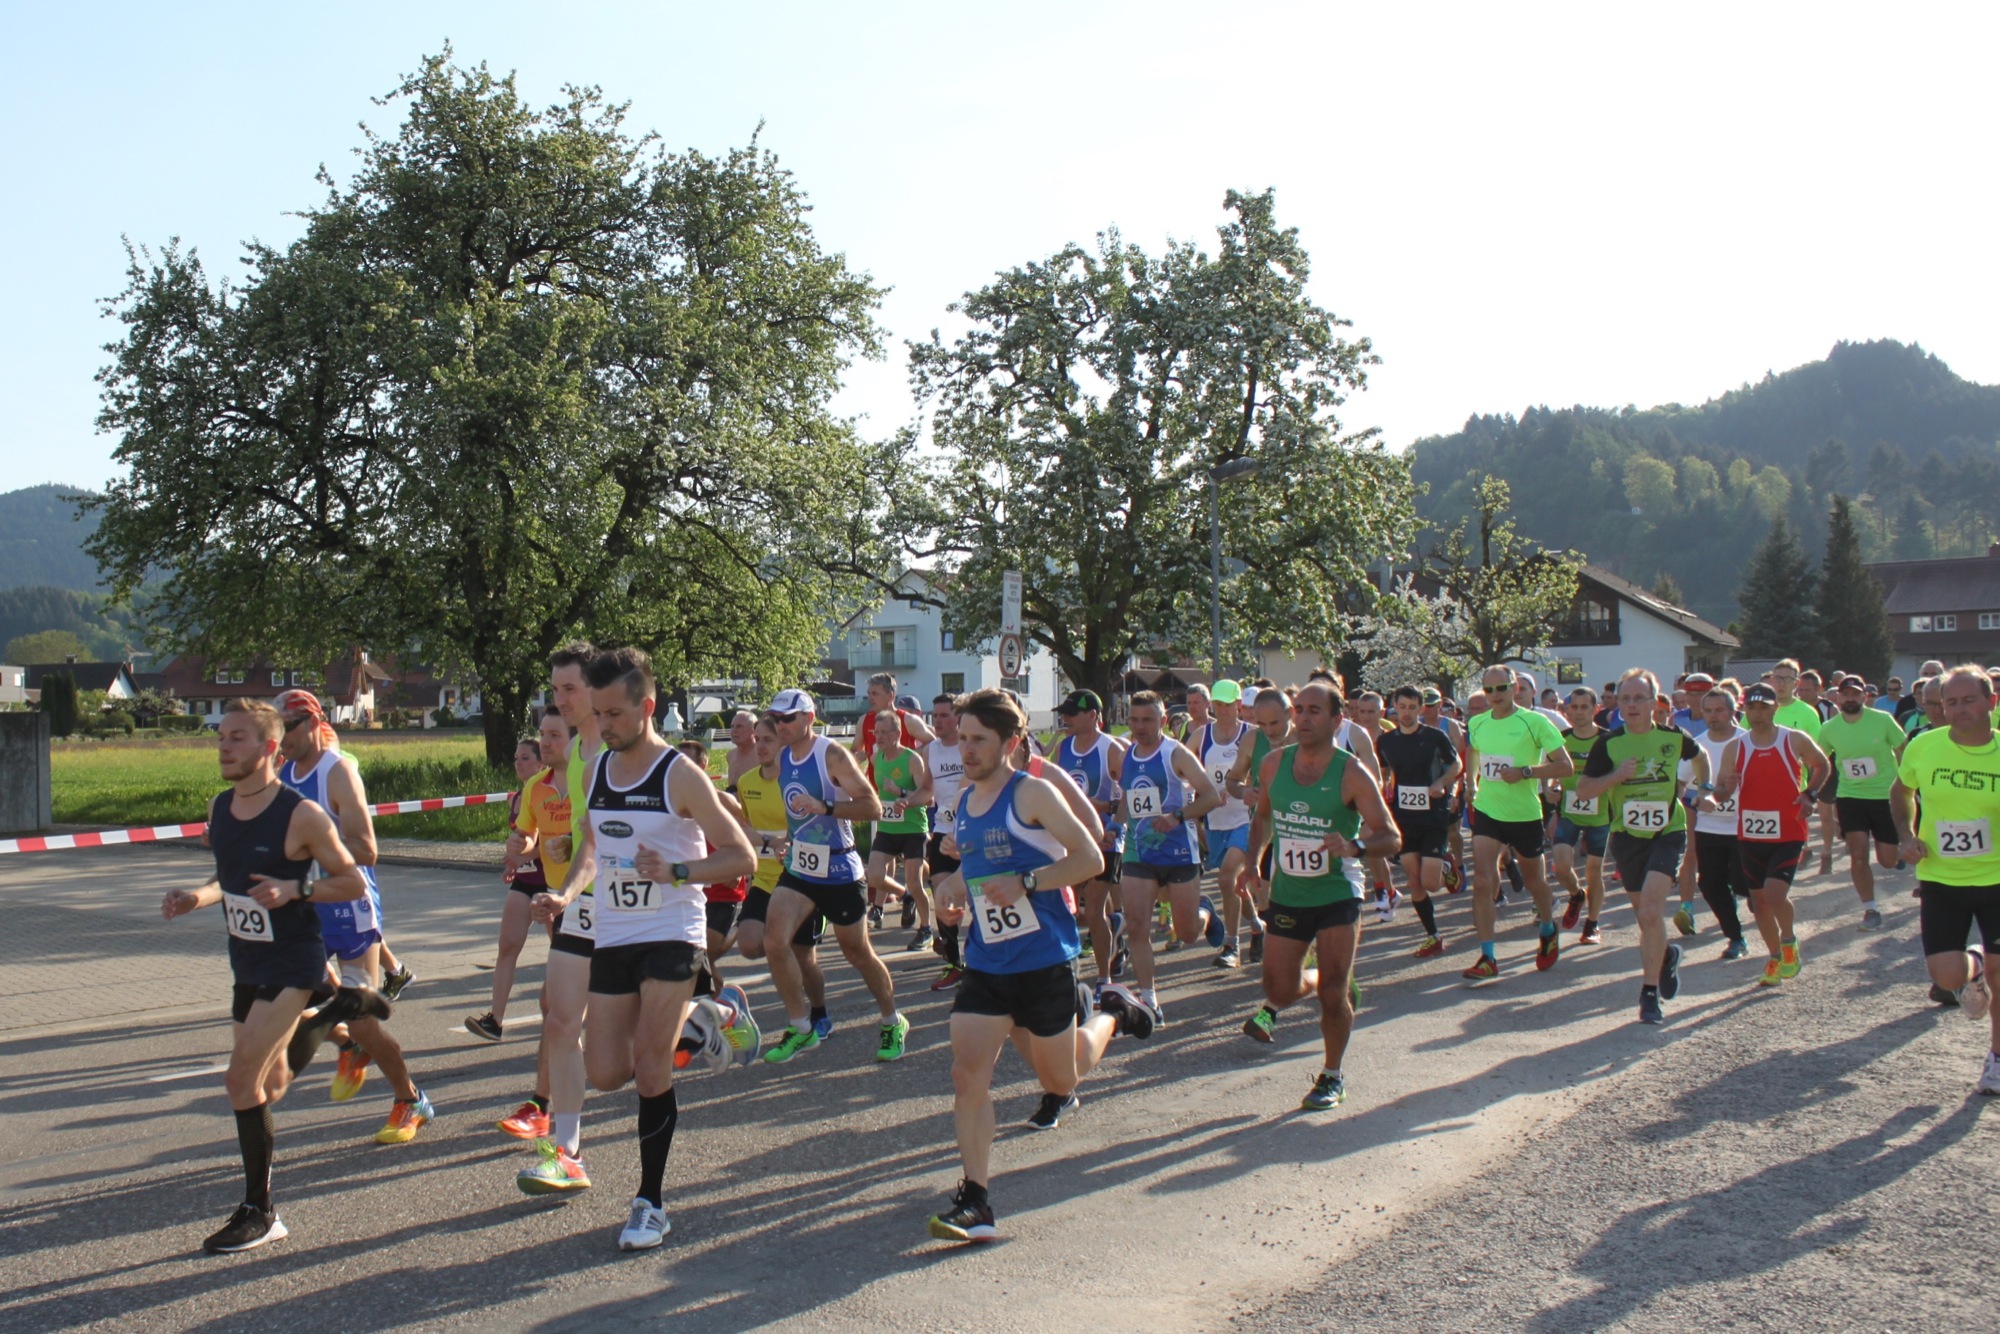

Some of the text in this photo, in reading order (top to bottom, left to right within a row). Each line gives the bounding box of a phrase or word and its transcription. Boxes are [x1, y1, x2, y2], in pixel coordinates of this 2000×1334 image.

[1851, 764, 1867, 776] 51
[1133, 796, 1152, 813] 64
[1401, 792, 1427, 806] 228
[1572, 798, 1591, 811] 42
[944, 810, 957, 822] 3
[1272, 809, 1332, 828] SUBARU
[1628, 810, 1664, 826] 215
[1745, 818, 1777, 834] 222
[1941, 829, 1984, 852] 231
[799, 851, 819, 871] 59
[1285, 849, 1323, 870] 119
[608, 881, 653, 908] 157
[229, 906, 265, 934] 129
[986, 904, 1022, 934] 56
